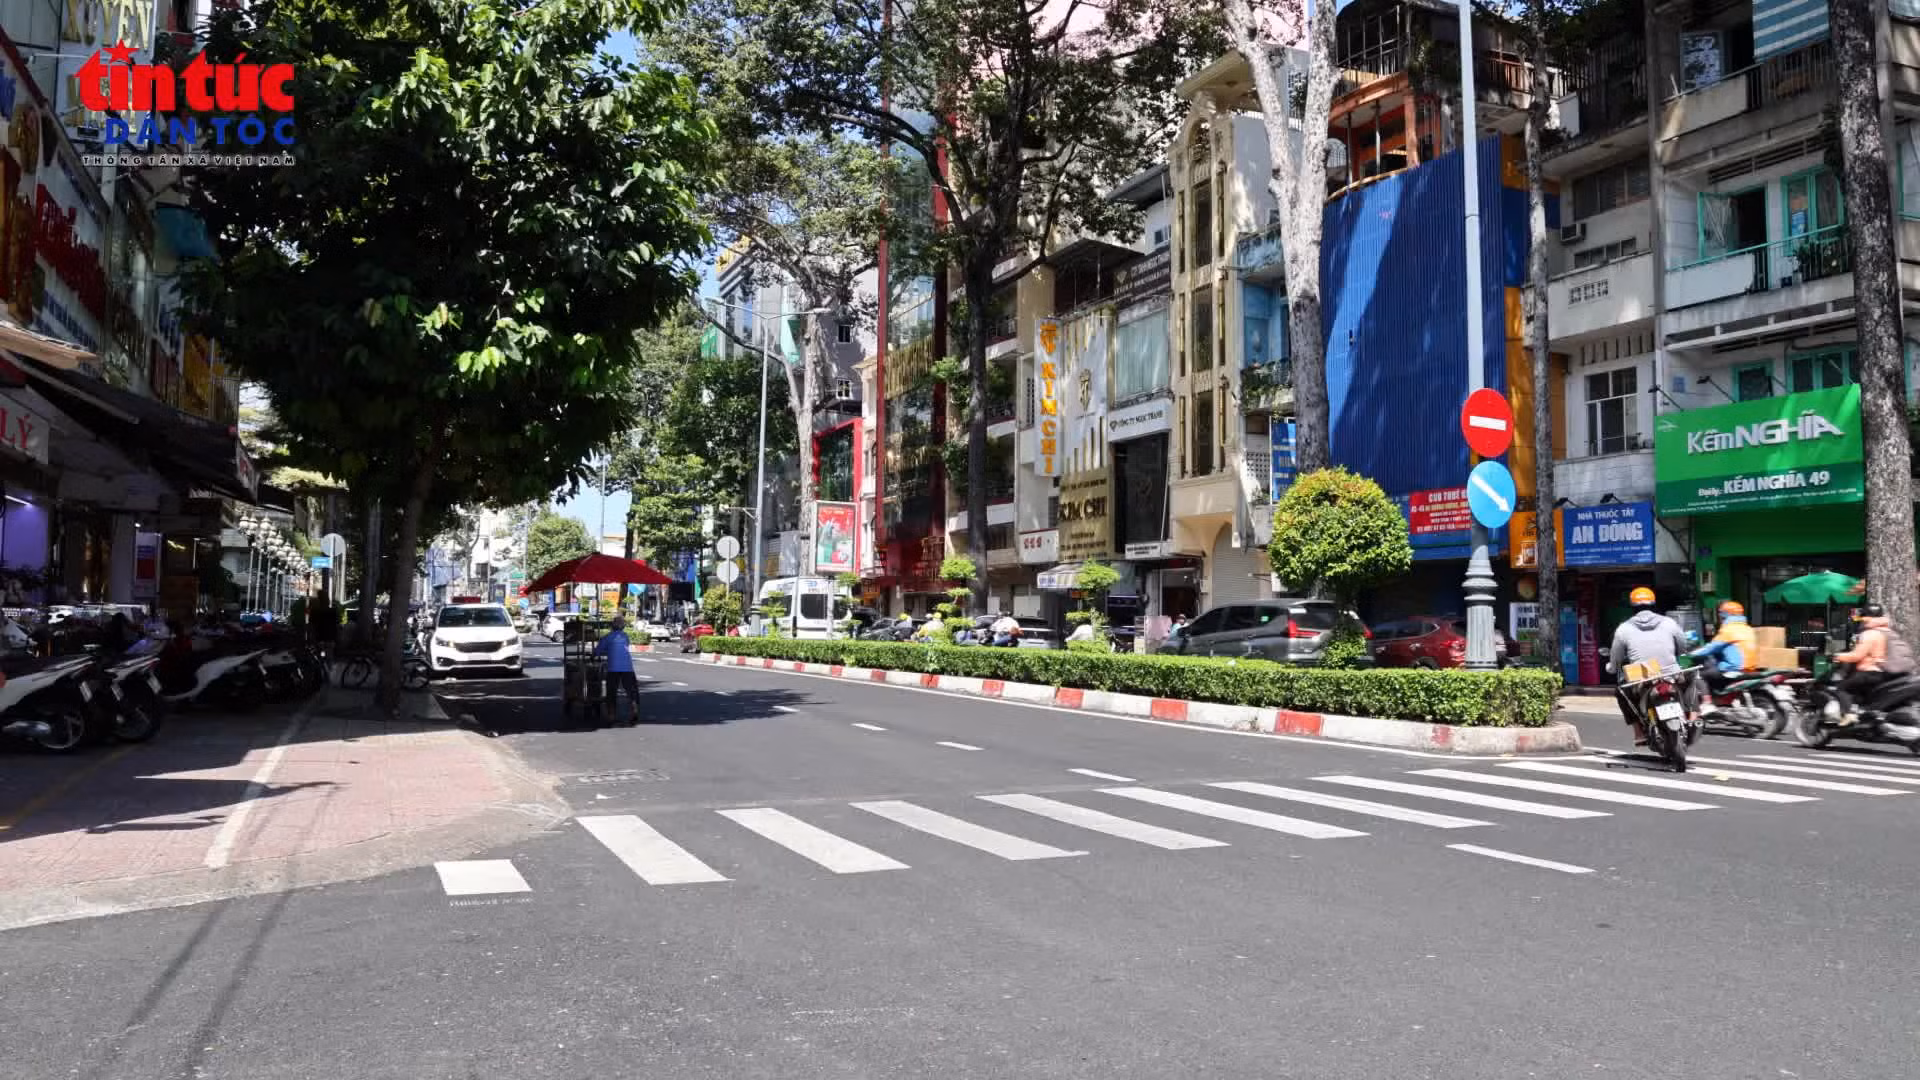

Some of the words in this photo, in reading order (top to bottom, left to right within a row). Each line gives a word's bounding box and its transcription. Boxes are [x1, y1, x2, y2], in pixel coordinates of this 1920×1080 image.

[1809, 471, 1830, 486] 49
[1572, 525, 1595, 544] AN
[1598, 519, 1643, 542] ĐÔNG
